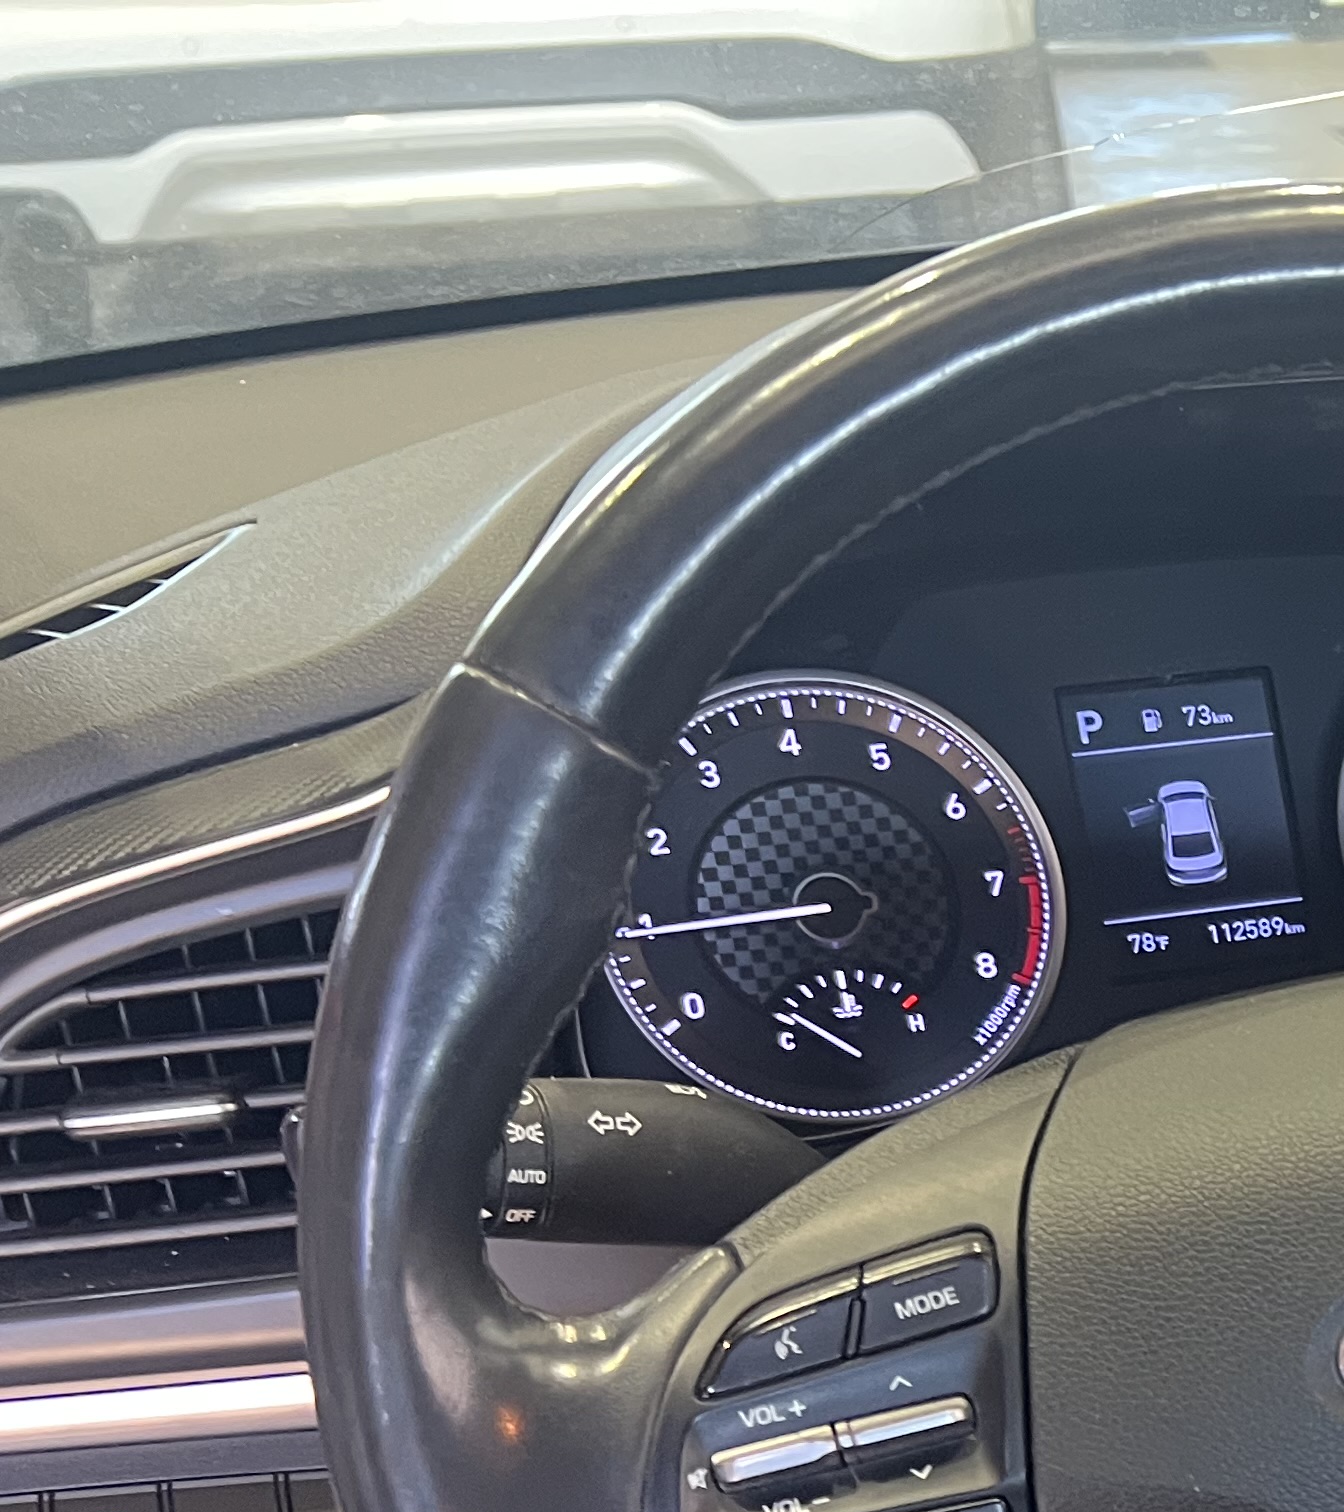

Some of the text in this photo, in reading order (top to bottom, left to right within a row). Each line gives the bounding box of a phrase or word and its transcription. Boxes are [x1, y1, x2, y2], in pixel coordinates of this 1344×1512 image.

[1075, 709, 1103, 744] P
[779, 729, 801, 756] 4
[869, 743, 891, 770] 5
[699, 761, 721, 788] 3
[945, 793, 966, 820] 6
[646, 829, 670, 856] 2
[983, 870, 1005, 897] 7
[975, 952, 997, 979] 8
[682, 993, 705, 1020] 0
[972, 984, 1021, 1046] x1000rpm
[907, 1013, 926, 1033] H
[778, 1031, 796, 1051] C
[508, 1168, 547, 1185] AUTO
[505, 1208, 537, 1223] OFF
[893, 1285, 961, 1320] MODE
